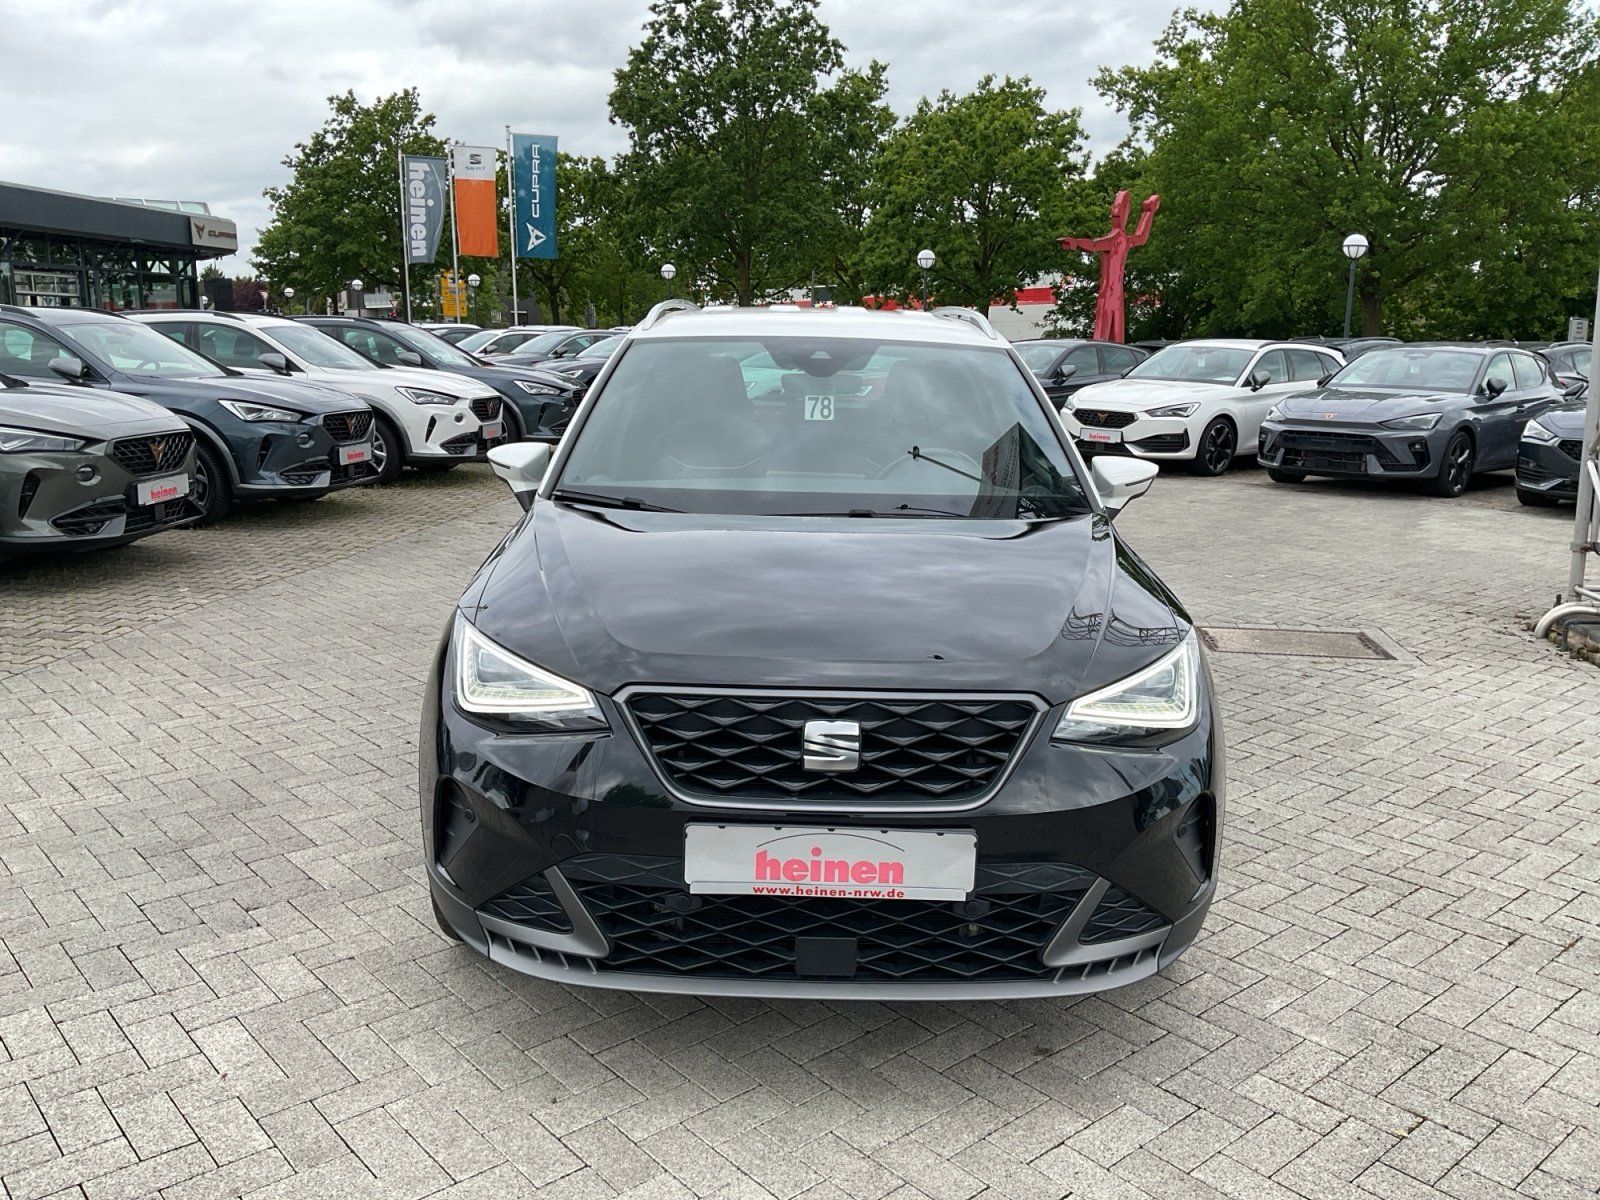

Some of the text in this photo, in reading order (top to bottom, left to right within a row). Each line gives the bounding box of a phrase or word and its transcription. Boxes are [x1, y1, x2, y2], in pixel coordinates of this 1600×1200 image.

[531, 143, 541, 218] CUPRA
[409, 162, 435, 257] heinen
[807, 396, 832, 420] 78
[150, 485, 177, 501] heinen
[755, 847, 904, 885] heinen
[752, 885, 905, 899] www.heinen-nrw.de
